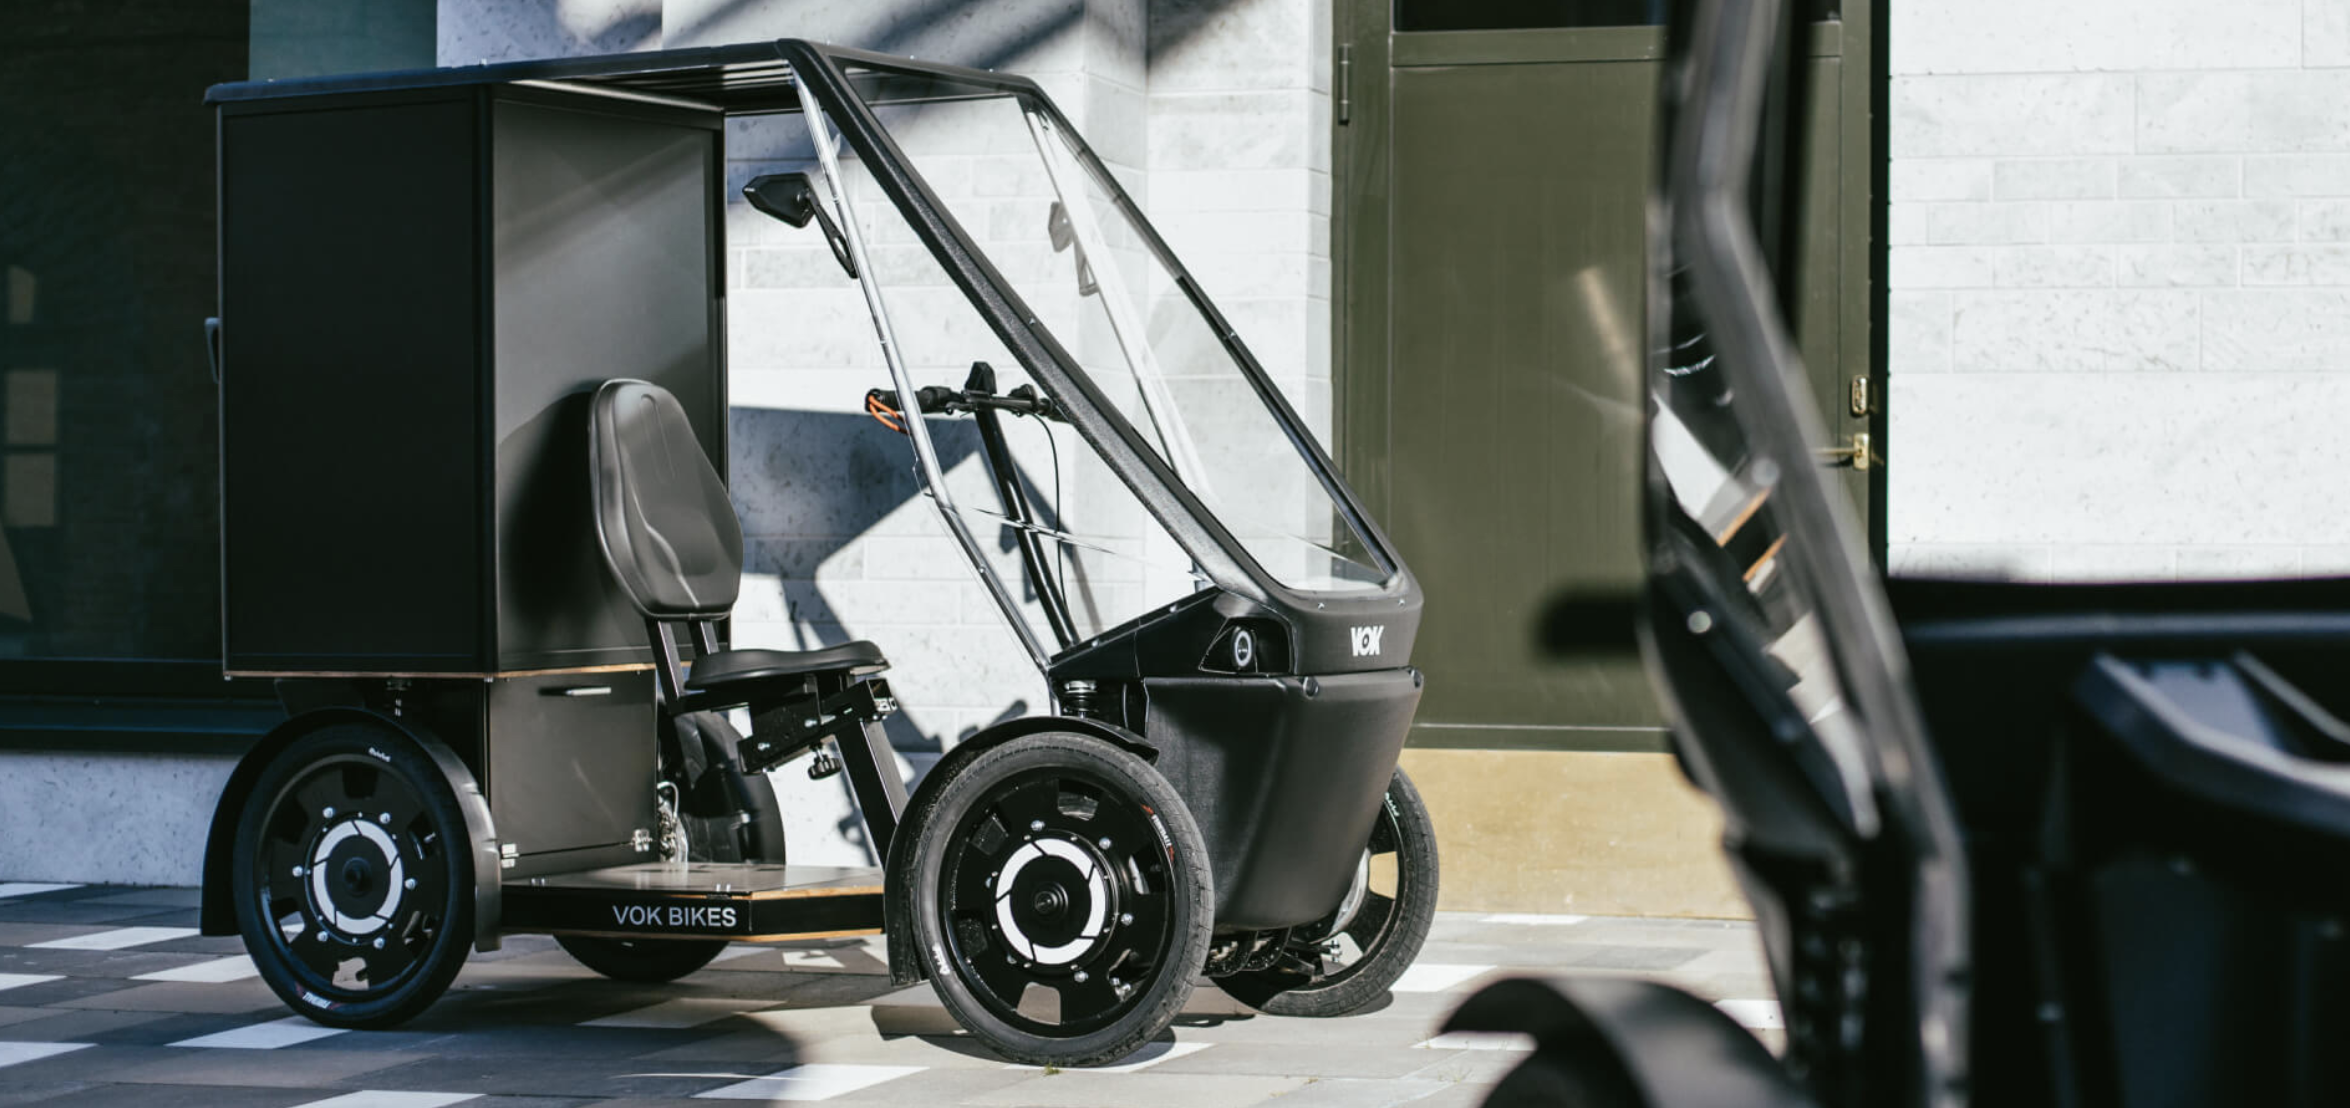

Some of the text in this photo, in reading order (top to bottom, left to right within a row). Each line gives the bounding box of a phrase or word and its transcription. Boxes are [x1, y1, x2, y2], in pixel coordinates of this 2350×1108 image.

[1350, 625, 1384, 657] VOK
[612, 905, 737, 927] VOK BIKES
